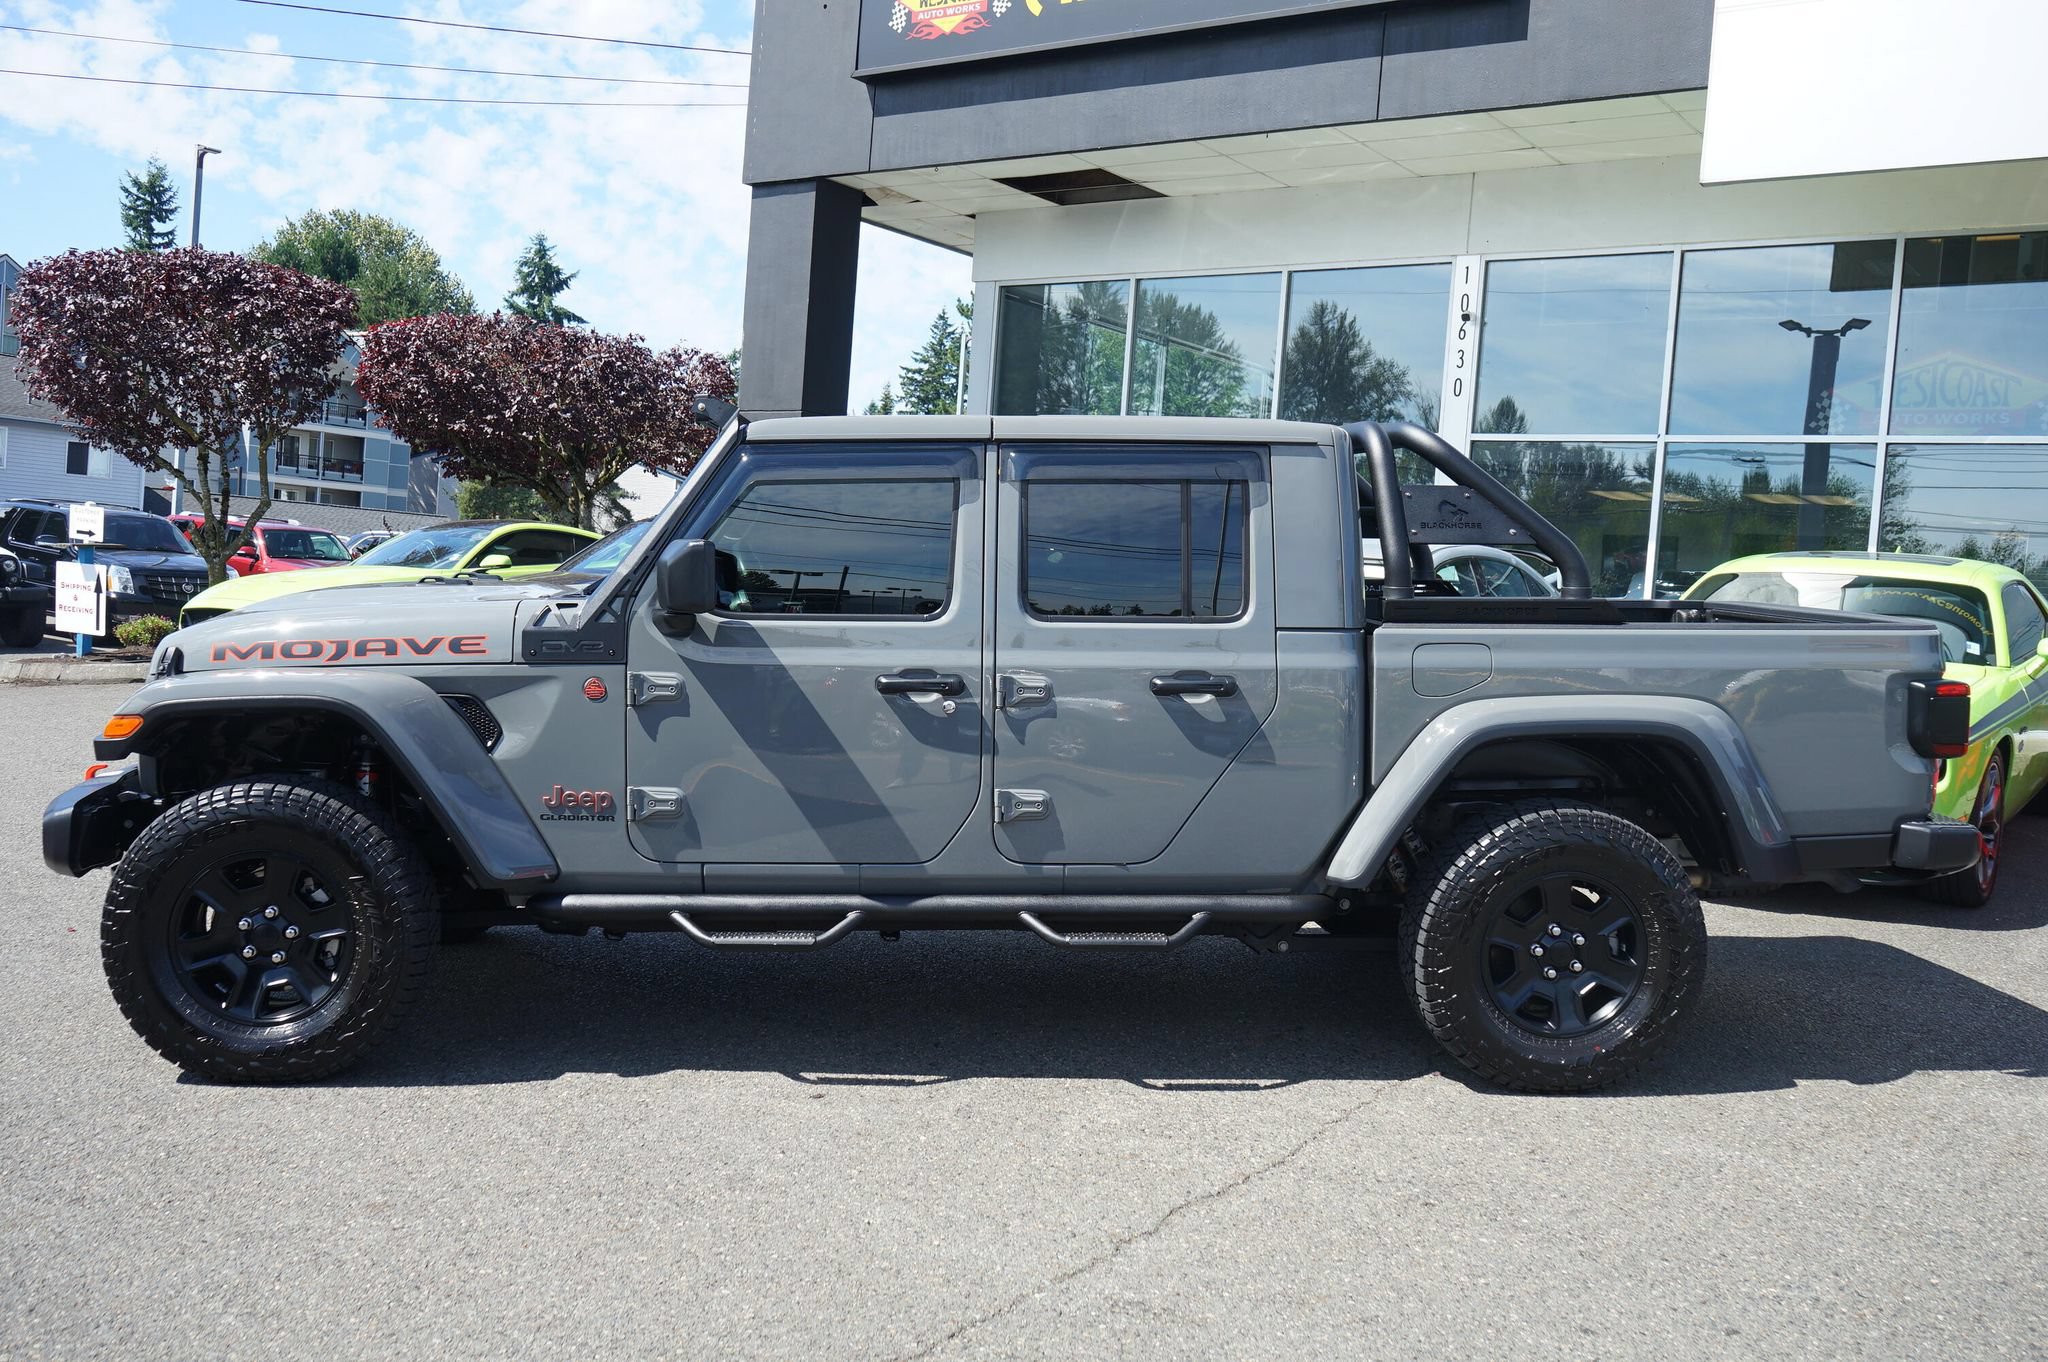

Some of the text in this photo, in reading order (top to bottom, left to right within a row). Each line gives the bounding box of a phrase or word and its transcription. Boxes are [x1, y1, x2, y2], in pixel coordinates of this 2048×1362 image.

[917, 9, 944, 21] AUTO
[946, 3, 982, 16] WORKS
[1935, 412, 2010, 425] WORKS
[1420, 521, 1483, 530] BLACKHORSE
[60, 581, 92, 592] SHIPPING
[58, 603, 95, 615] RECEIVING
[209, 634, 489, 663] MOJAVE
[542, 784, 613, 813] Jeep
[539, 813, 616, 822] GLADIATOR
